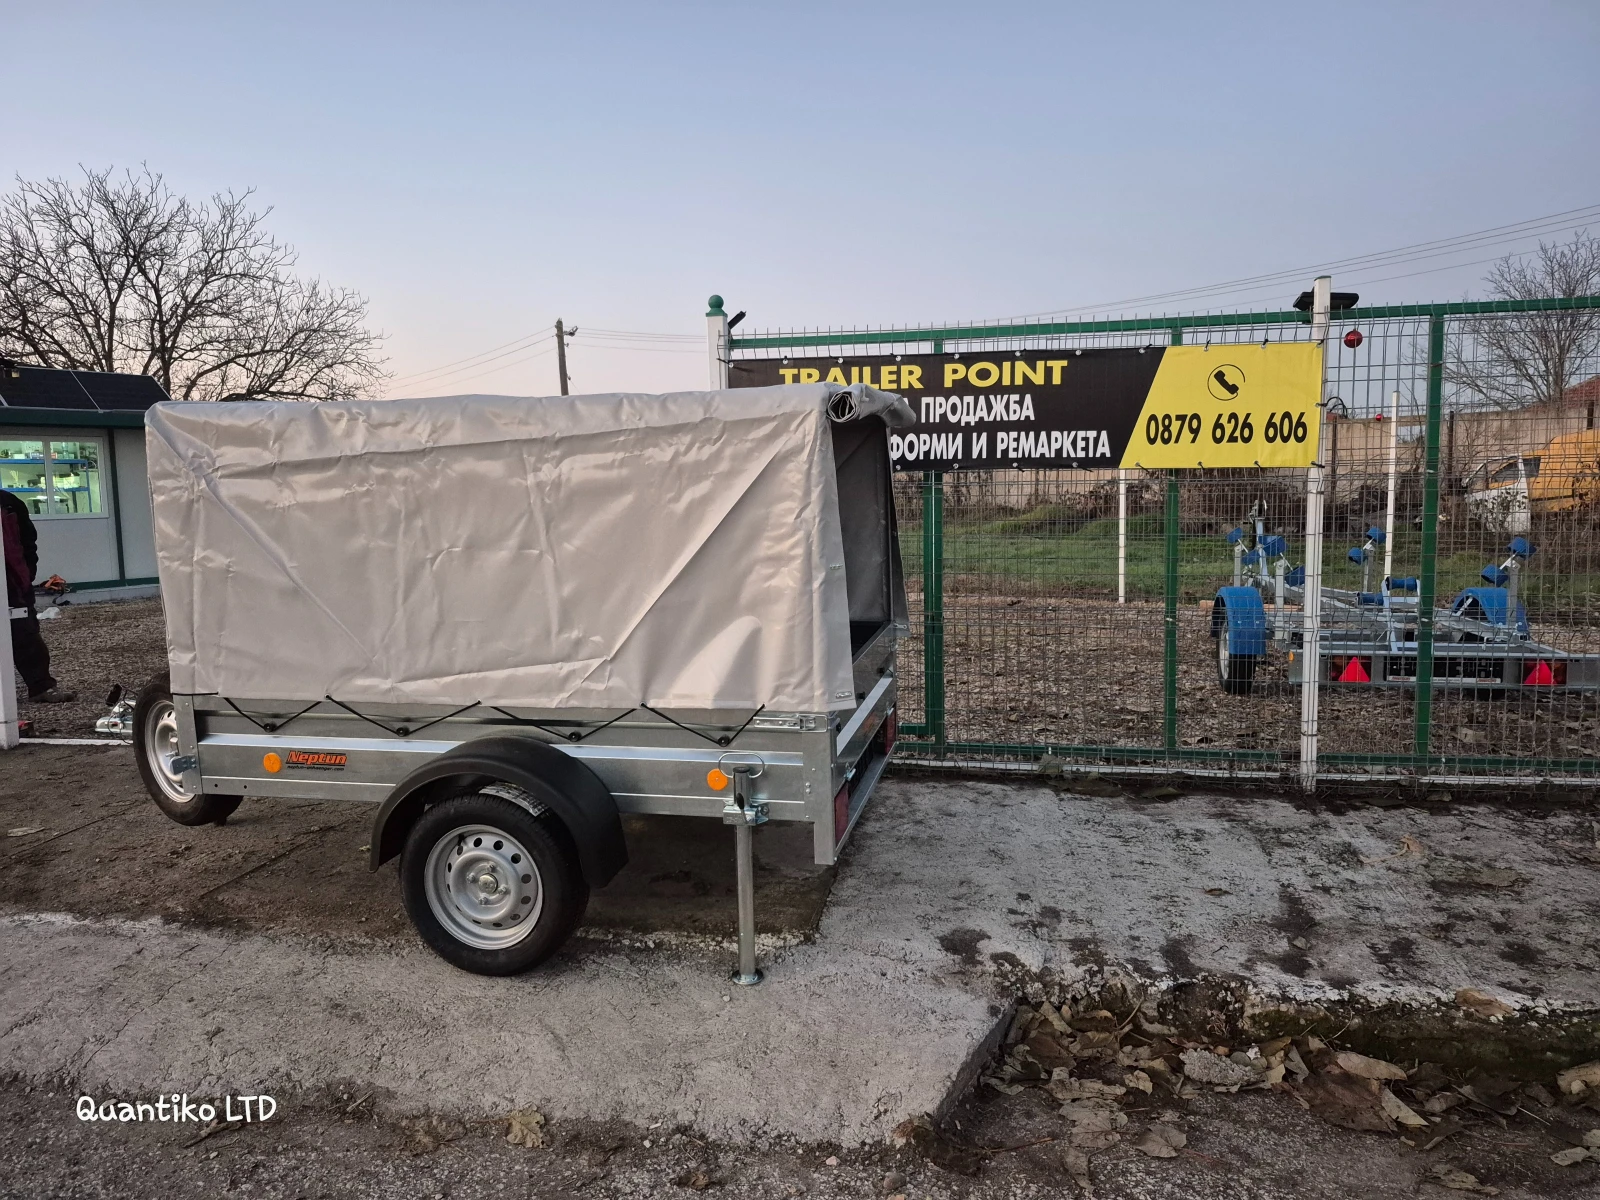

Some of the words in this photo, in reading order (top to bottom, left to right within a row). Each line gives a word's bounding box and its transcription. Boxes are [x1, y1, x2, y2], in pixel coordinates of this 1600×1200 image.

[779, 365, 924, 390] TRAILER
[944, 360, 1068, 388] POINT
[921, 393, 1035, 426] ПРОДАЖБА
[1146, 412, 1202, 446] 0879
[1211, 411, 1254, 445] 626
[1264, 410, 1308, 444] 606
[972, 432, 987, 459] И
[996, 430, 1111, 459] РЕМАРКЕТА
[287, 750, 347, 765] Neptun
